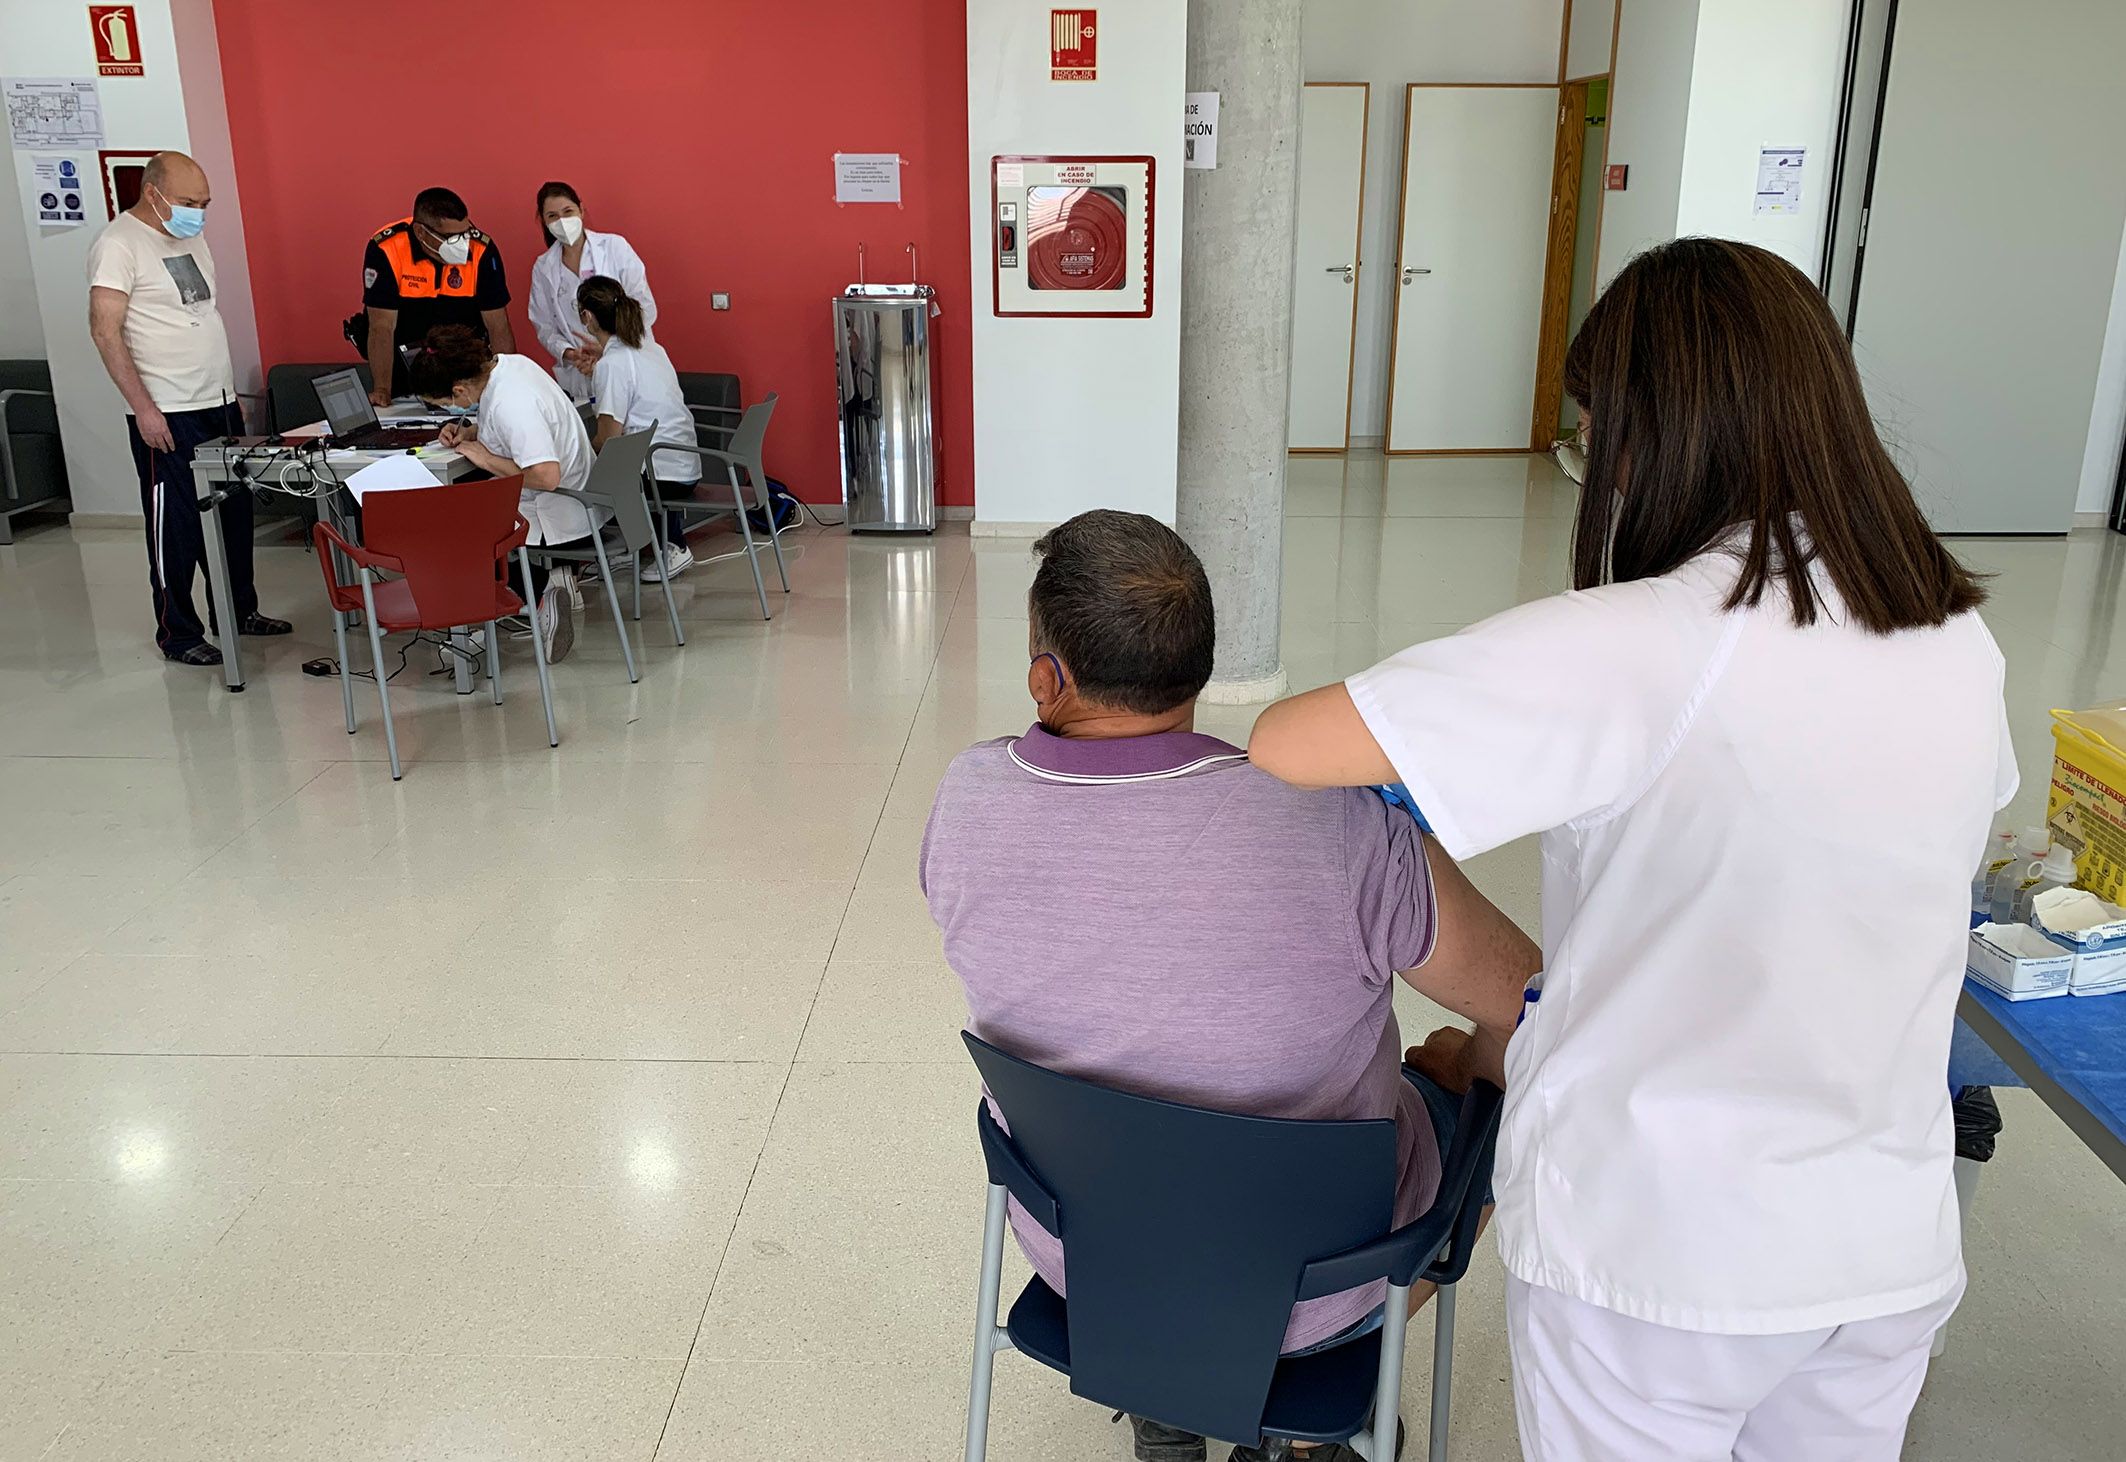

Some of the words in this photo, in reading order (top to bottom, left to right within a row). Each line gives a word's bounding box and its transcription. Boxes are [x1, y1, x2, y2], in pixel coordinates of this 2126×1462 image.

[101, 66, 141, 74] EXTINTOR
[1190, 104, 1199, 115] DE
[2085, 774, 2096, 786] DE
[2051, 777, 2075, 797] PELIGRO
